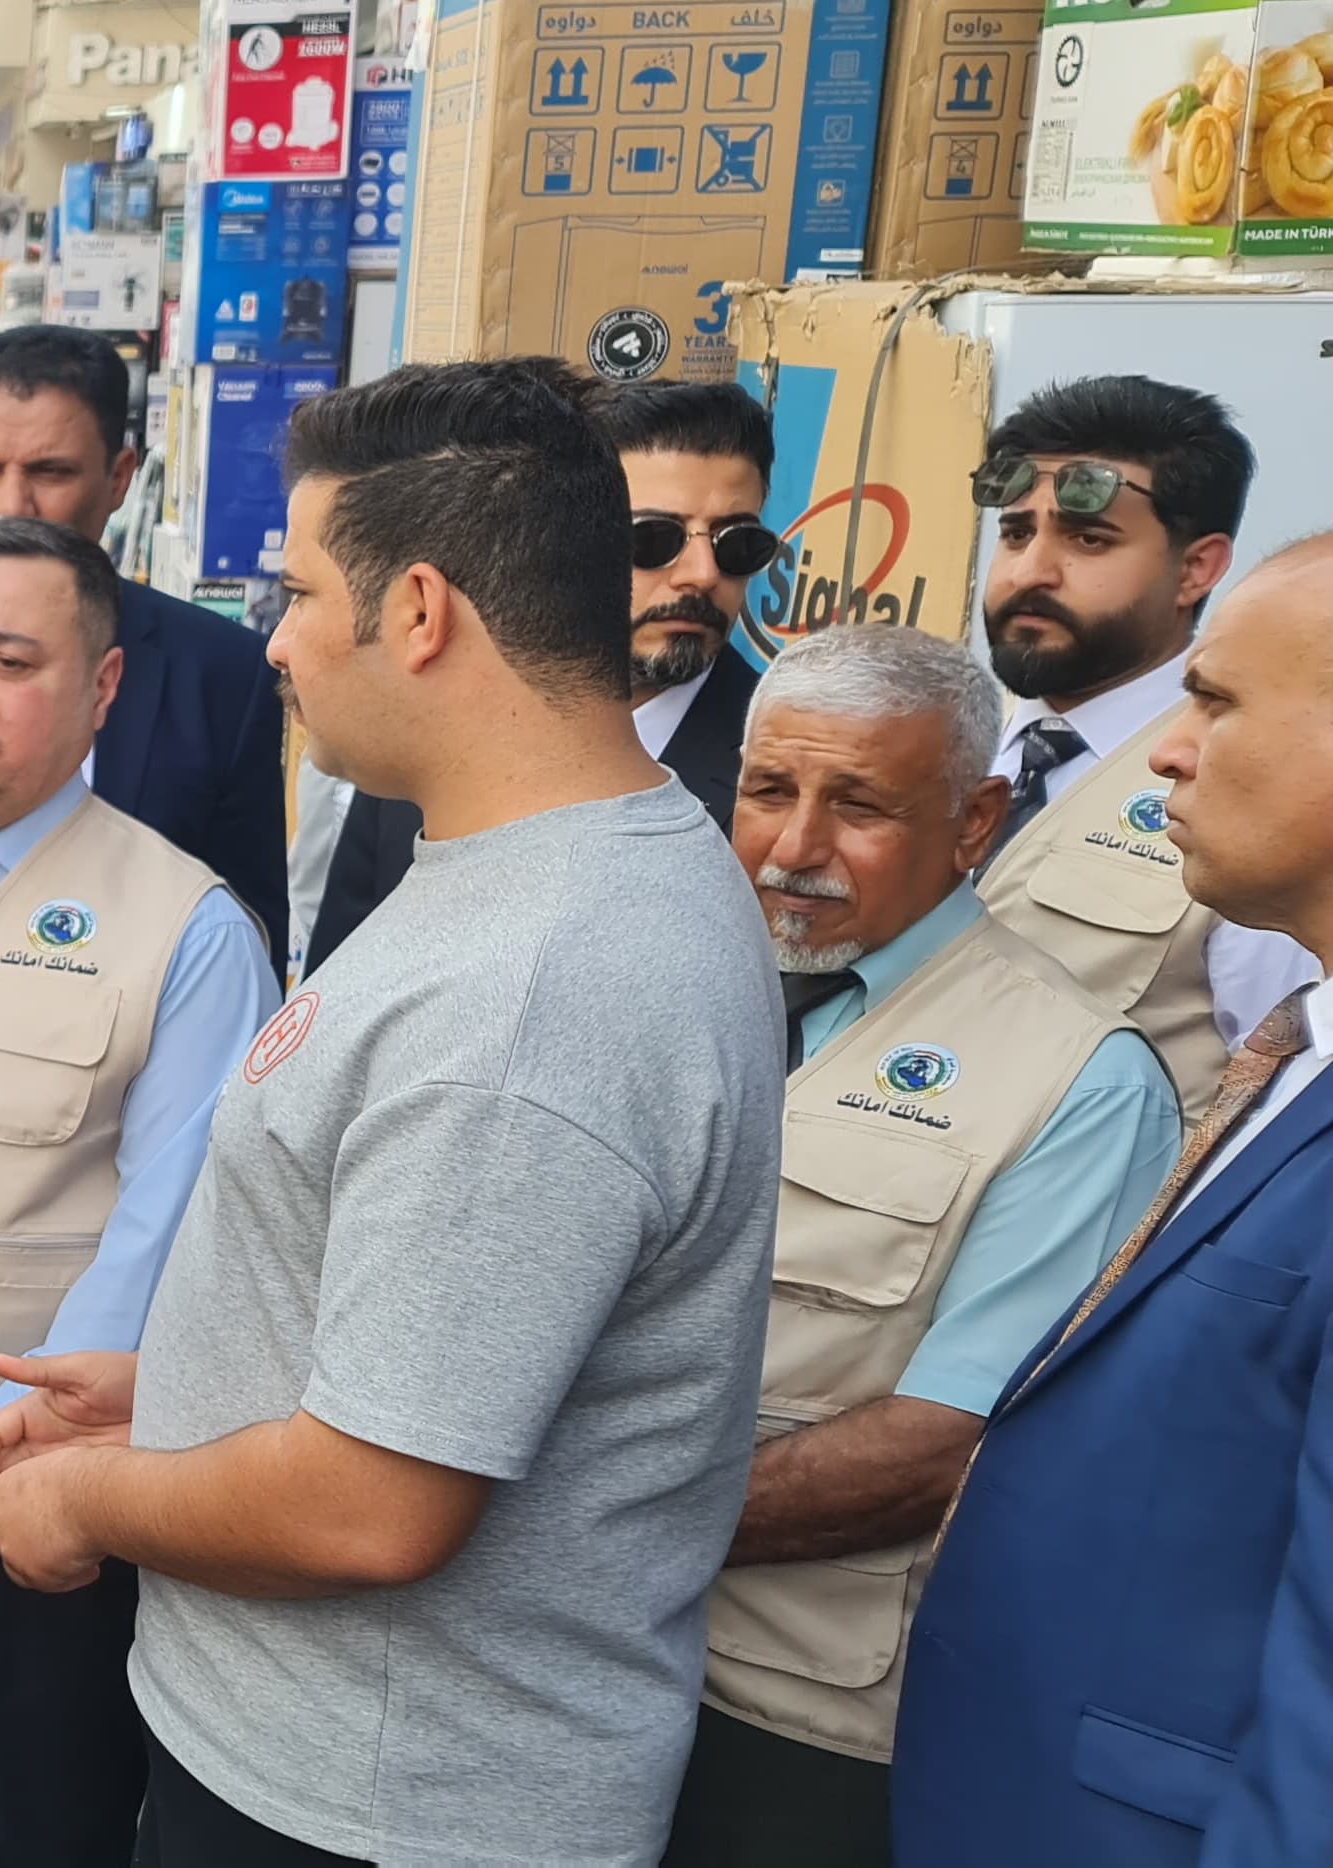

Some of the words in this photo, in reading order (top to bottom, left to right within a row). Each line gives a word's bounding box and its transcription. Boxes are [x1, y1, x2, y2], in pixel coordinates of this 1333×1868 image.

[633, 12, 690, 29] BACK
[730, 9, 775, 26] خلف
[1244, 230, 1283, 240] MADE
[1285, 229, 1299, 239] IN
[694, 281, 733, 334] 3
[684, 336, 734, 348] YEAR
[1084, 831, 1129, 851] امانك
[1128, 842, 1179, 867] ضمانك
[0, 949, 44, 968] امانك
[44, 955, 99, 976] ضمانك
[836, 1092, 889, 1114] امانك
[888, 1102, 953, 1130] ضمانك
